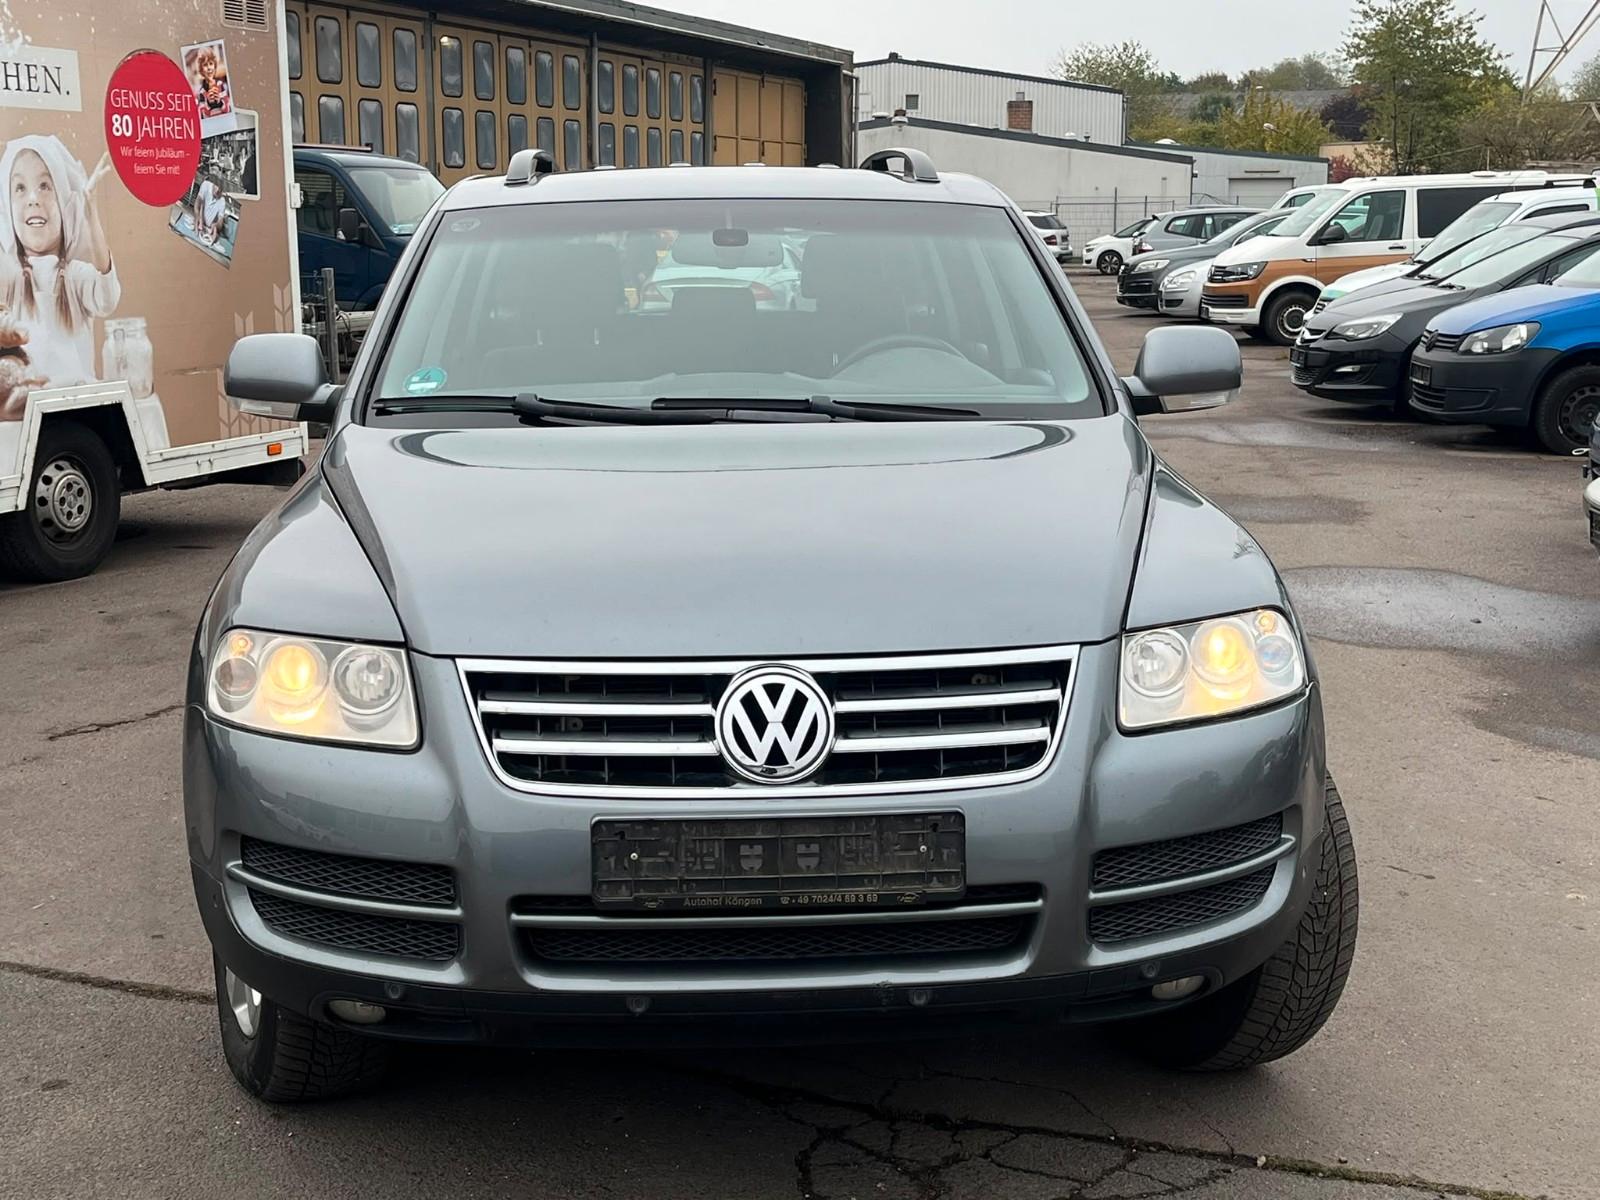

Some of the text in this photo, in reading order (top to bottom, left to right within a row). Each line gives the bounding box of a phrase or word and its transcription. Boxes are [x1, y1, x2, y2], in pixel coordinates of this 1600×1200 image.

[1, 61, 70, 96] HEN.
[110, 88, 192, 112] GENUSS SEIT
[111, 113, 195, 143] 80 JAHREN
[120, 145, 133, 157] Wir
[134, 145, 154, 158] feiern
[155, 147, 185, 160] Jubiläum
[133, 162, 154, 175] feiern
[155, 163, 166, 175] Sie
[683, 895, 723, 906] Autohof
